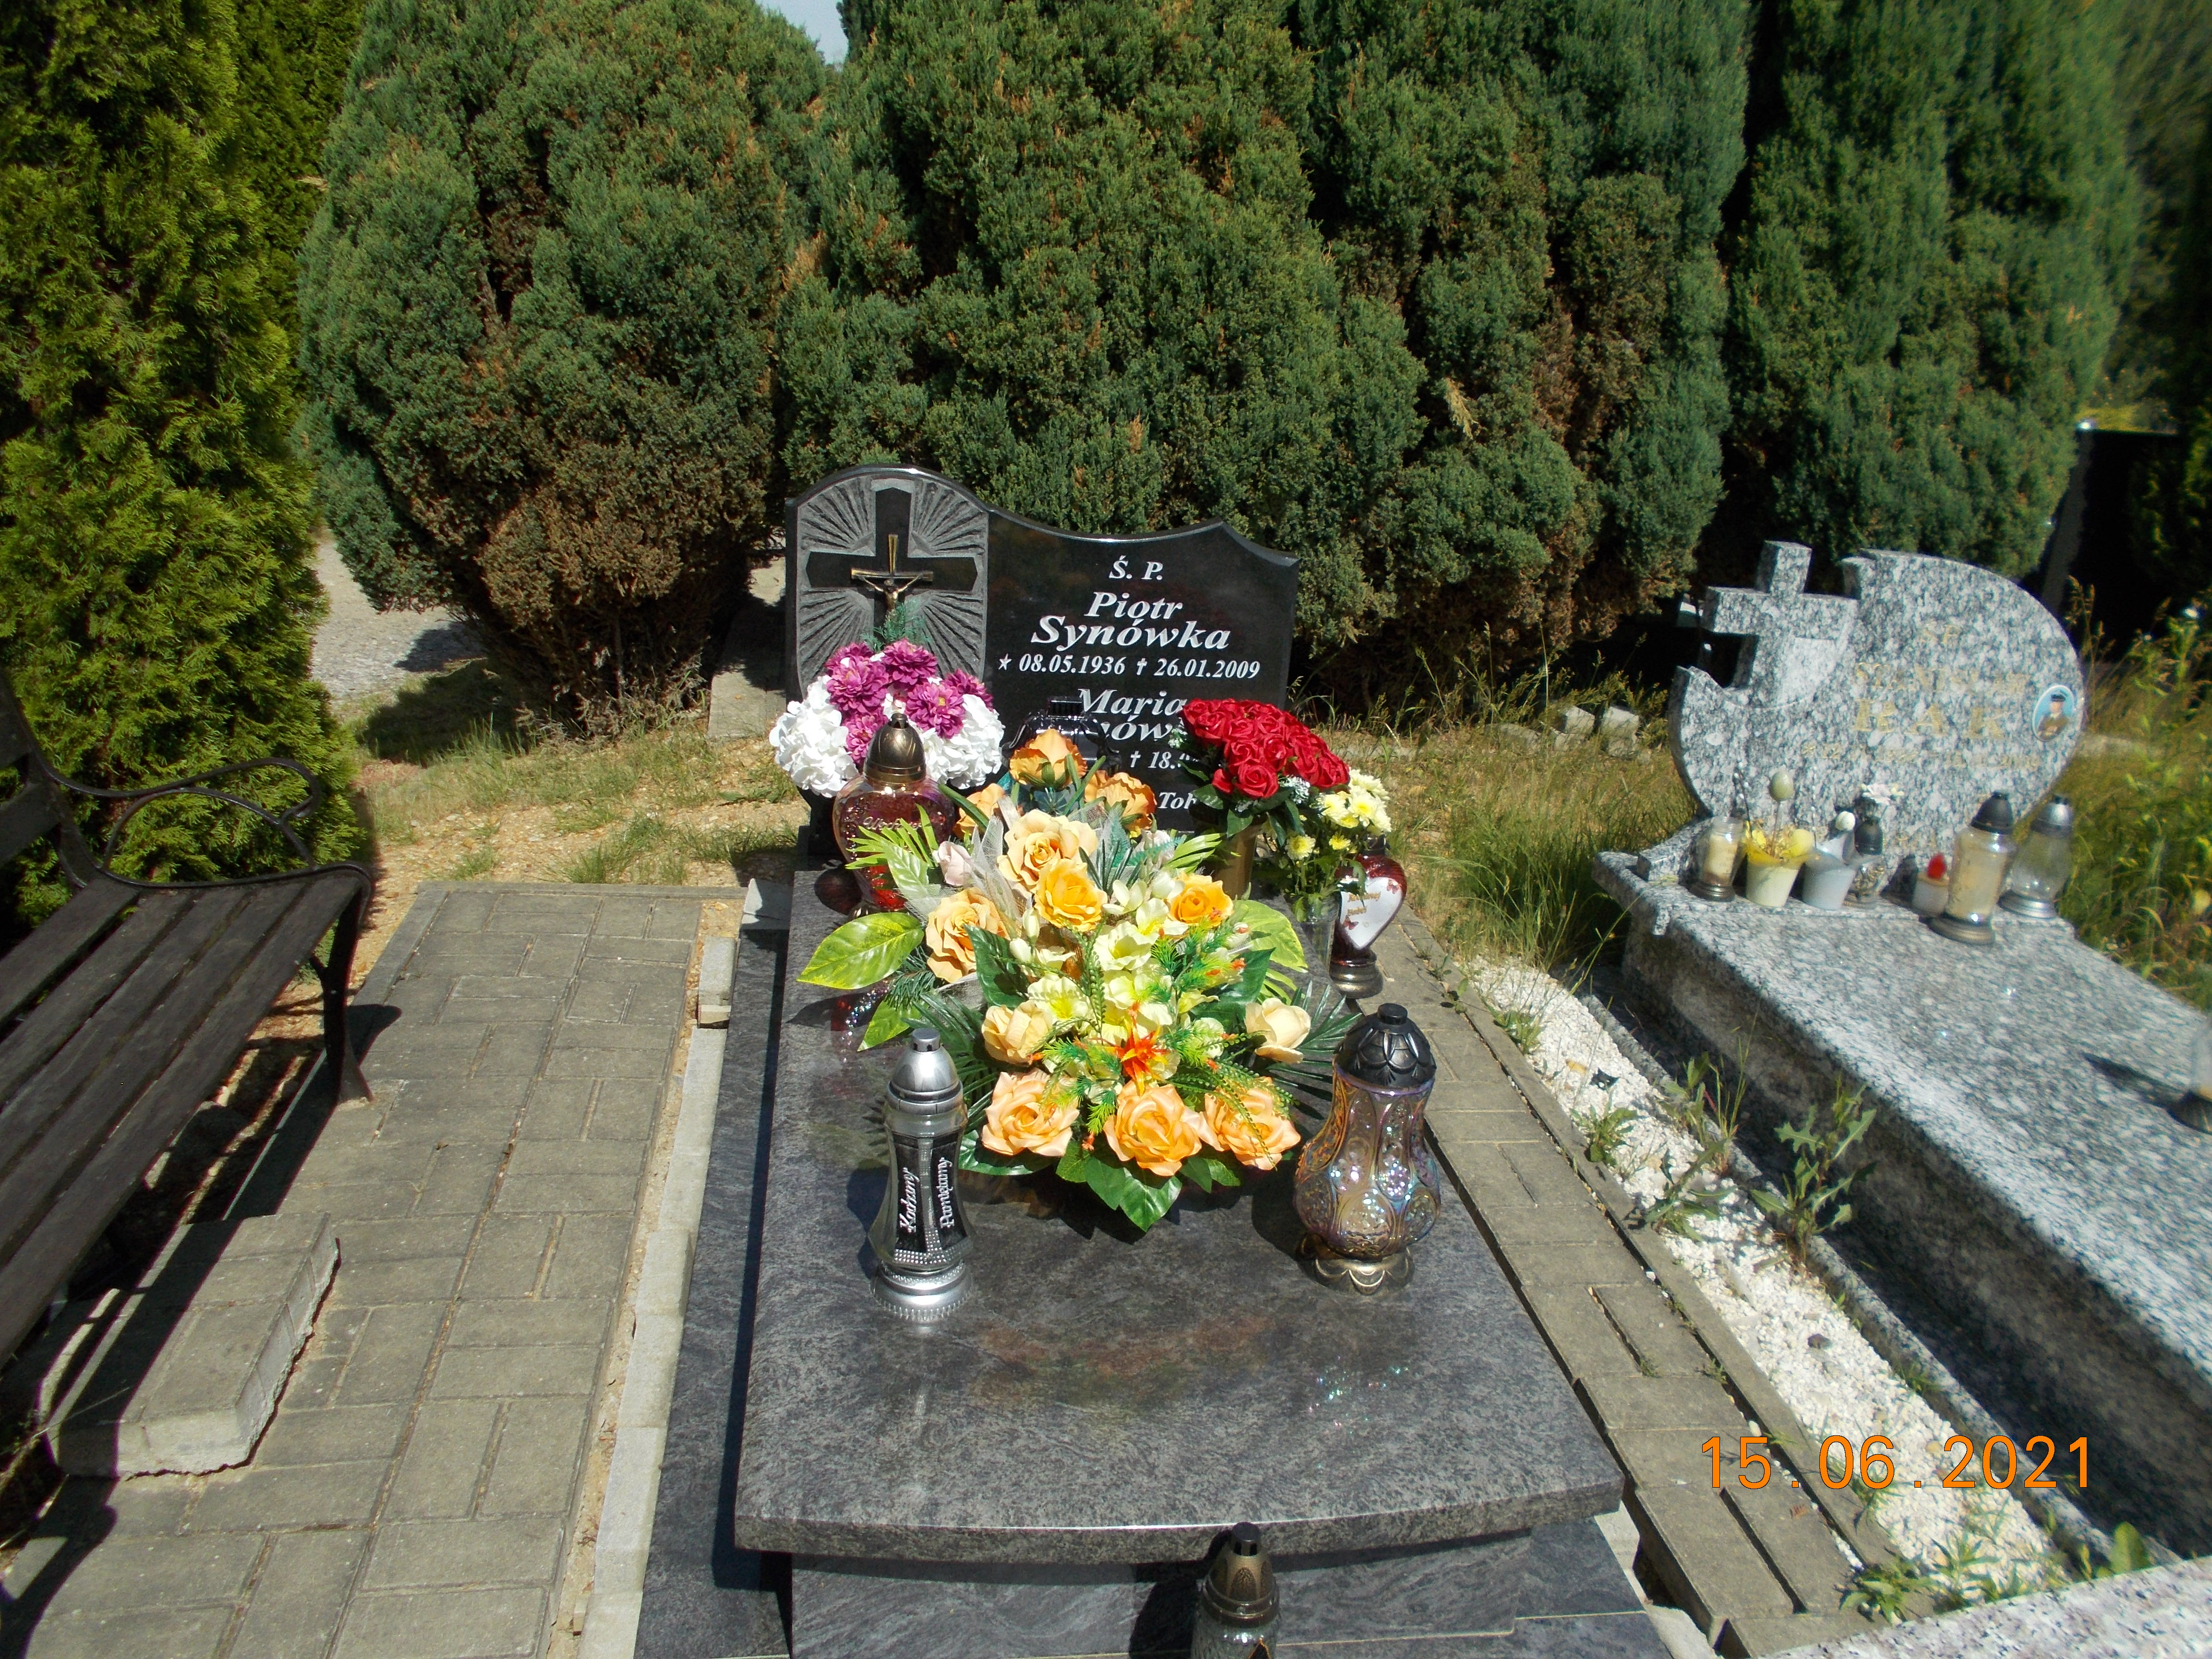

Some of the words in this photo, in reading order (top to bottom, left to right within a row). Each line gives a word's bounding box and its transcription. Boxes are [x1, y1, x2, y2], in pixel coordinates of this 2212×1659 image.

[1108, 555, 1132, 579] Ś.
[1141, 561, 1163, 580] P.
[1083, 591, 1183, 619] Piotr
[1031, 615, 1231, 651] Synówka
[1019, 653, 1127, 674] 08.05.1936
[1154, 658, 1260, 679] 26.01.2009
[1078, 688, 1188, 716] Maria
[899, 1167, 920, 1233] Kochamy
[936, 1157, 955, 1228] Pamiętamy
